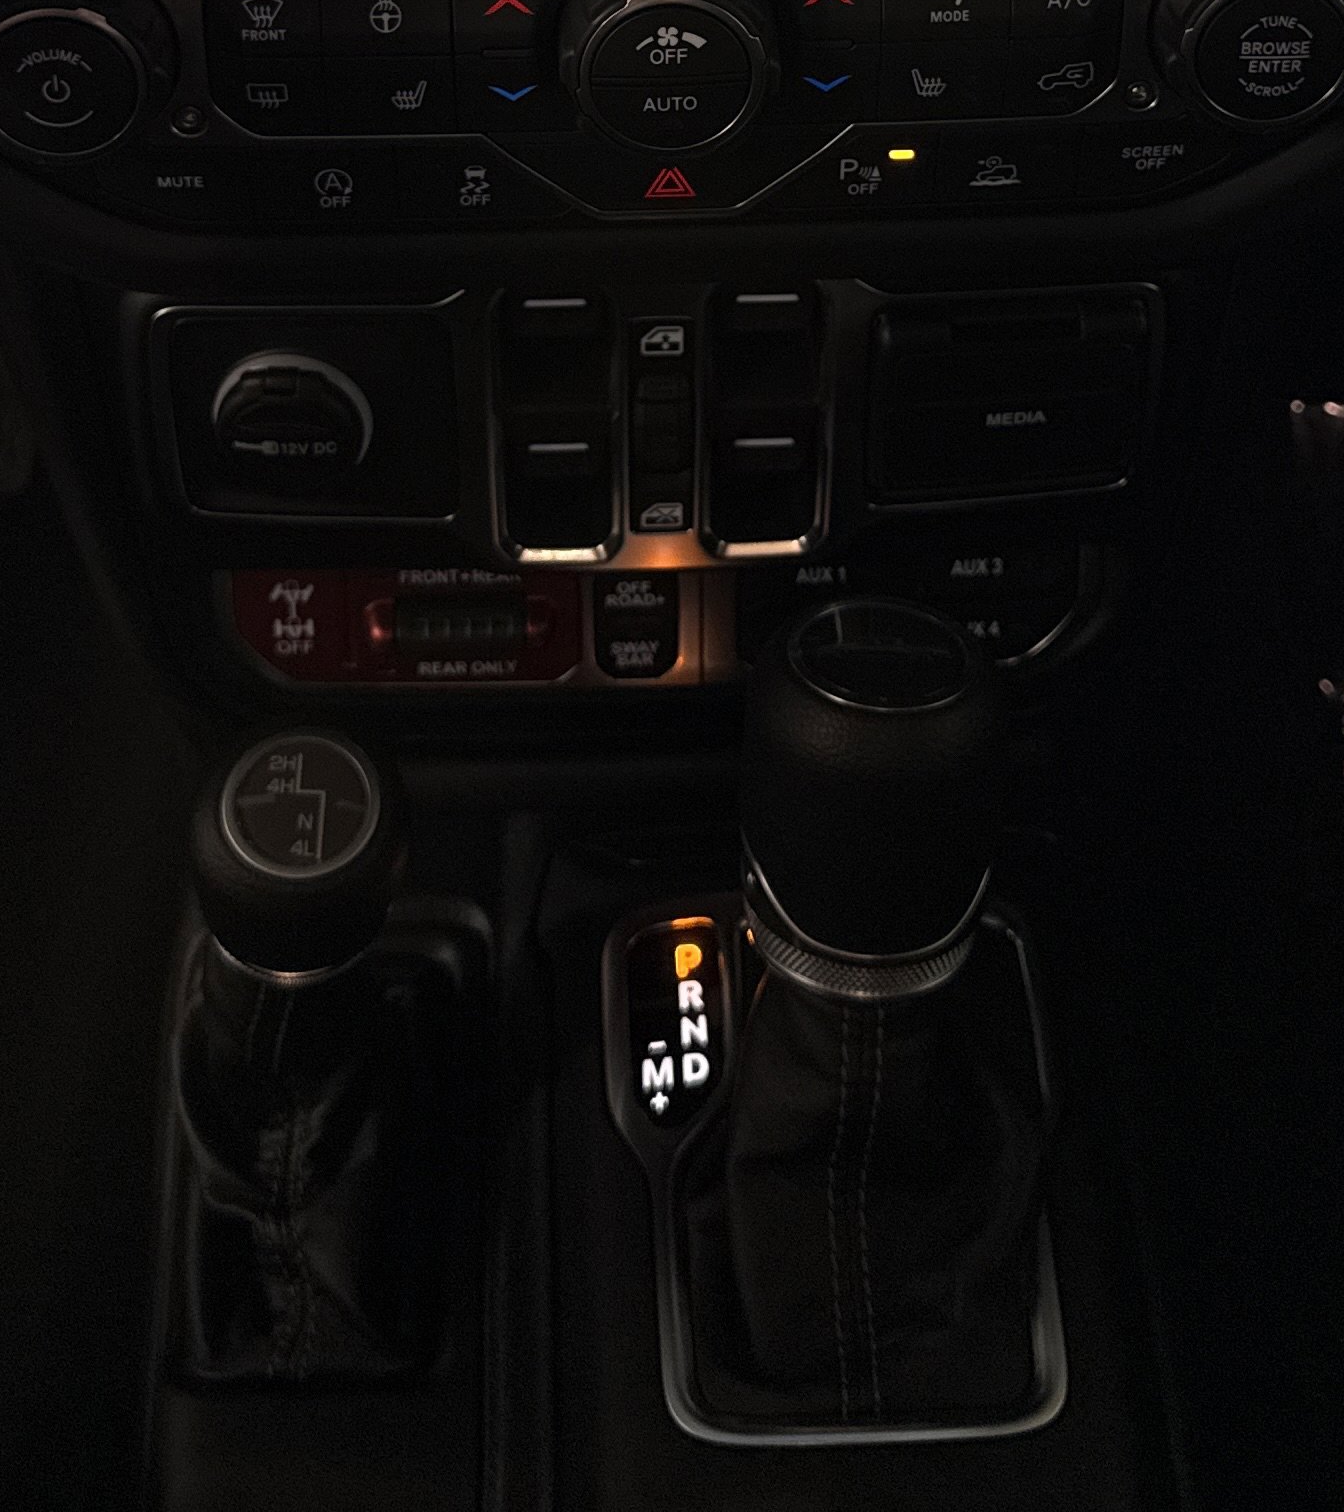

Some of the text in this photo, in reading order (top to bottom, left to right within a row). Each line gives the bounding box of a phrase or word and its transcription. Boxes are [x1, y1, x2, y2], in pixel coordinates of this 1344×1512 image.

[930, 11, 970, 23] MODE
[1260, 16, 1299, 29] TUNE
[242, 29, 286, 40] FRONT
[1241, 41, 1312, 55] BROWSE
[22, 49, 82, 66] VOLUME
[650, 48, 687, 65] OFF
[1248, 61, 1303, 73] ENTER
[1245, 83, 1298, 97] SCROLL
[643, 96, 698, 112] AUTO
[1122, 144, 1184, 159] SCREEN
[1135, 158, 1166, 170] OFF
[158, 176, 203, 187] MUTE
[847, 183, 879, 195] OFF
[320, 196, 351, 208] OFF
[459, 194, 491, 206] OFF
[985, 409, 1048, 427] MEDIA
[280, 441, 338, 455] 12V DC
[951, 557, 989, 576] AUX
[796, 566, 834, 584] AUX
[615, 581, 652, 593] OFF
[274, 640, 313, 655] OFF
[418, 660, 518, 675] REAR ONLY
[269, 754, 296, 771] 2H
[266, 777, 295, 794] 4H
[296, 812, 314, 831] N
[289, 839, 314, 856] 4L
[675, 943, 702, 978] P
[678, 979, 704, 1013] R
[680, 1014, 708, 1049] N
[642, 1055, 674, 1093] M
[682, 1052, 709, 1088] D
